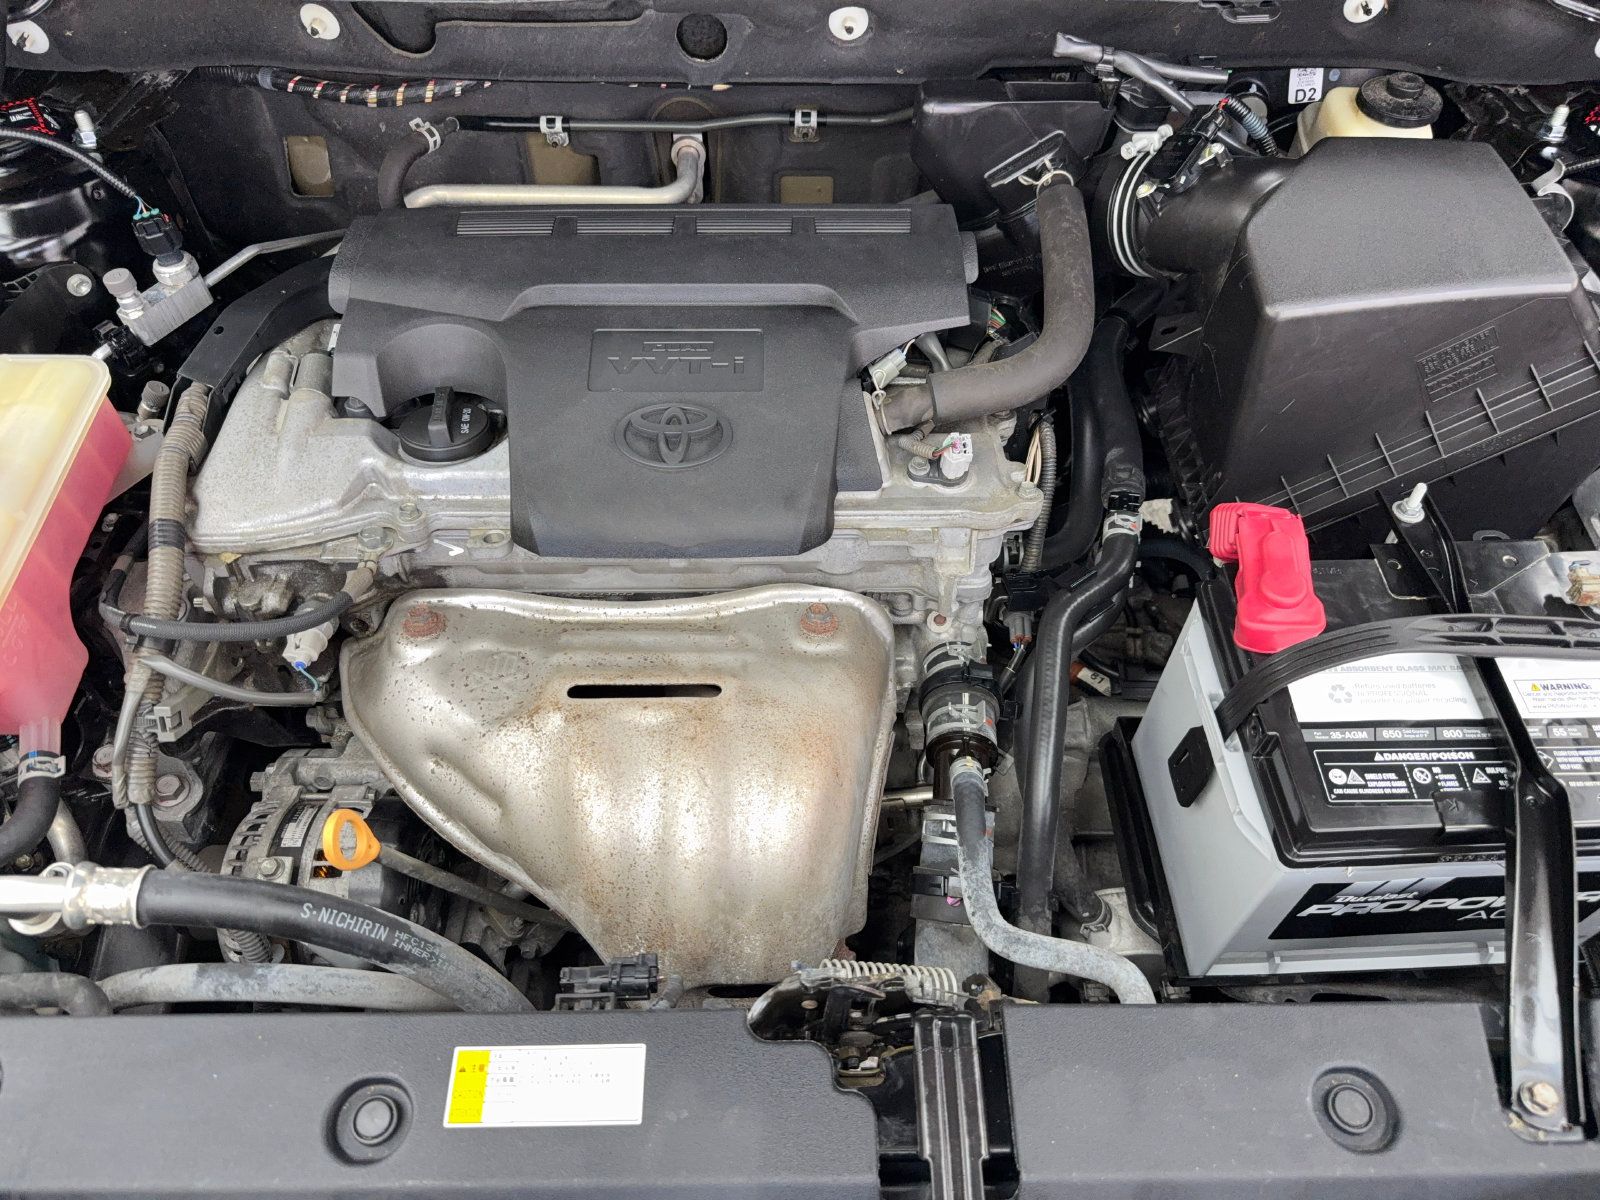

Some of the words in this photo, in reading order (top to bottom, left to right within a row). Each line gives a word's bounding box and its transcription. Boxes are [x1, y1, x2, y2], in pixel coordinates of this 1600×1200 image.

[1295, 88, 1316, 102] D2
[607, 356, 745, 374] VVT-i
[460, 423, 470, 434] SAE
[1541, 683, 1592, 691] WARNING:
[1432, 696, 1468, 704] recycling
[1329, 731, 1369, 740] 35-AGM
[1382, 730, 1402, 739] 650
[1442, 729, 1463, 739] 800
[1552, 728, 1568, 737] 55
[1383, 751, 1475, 761] DANGER/POISON
[1334, 892, 1419, 903] Duralast
